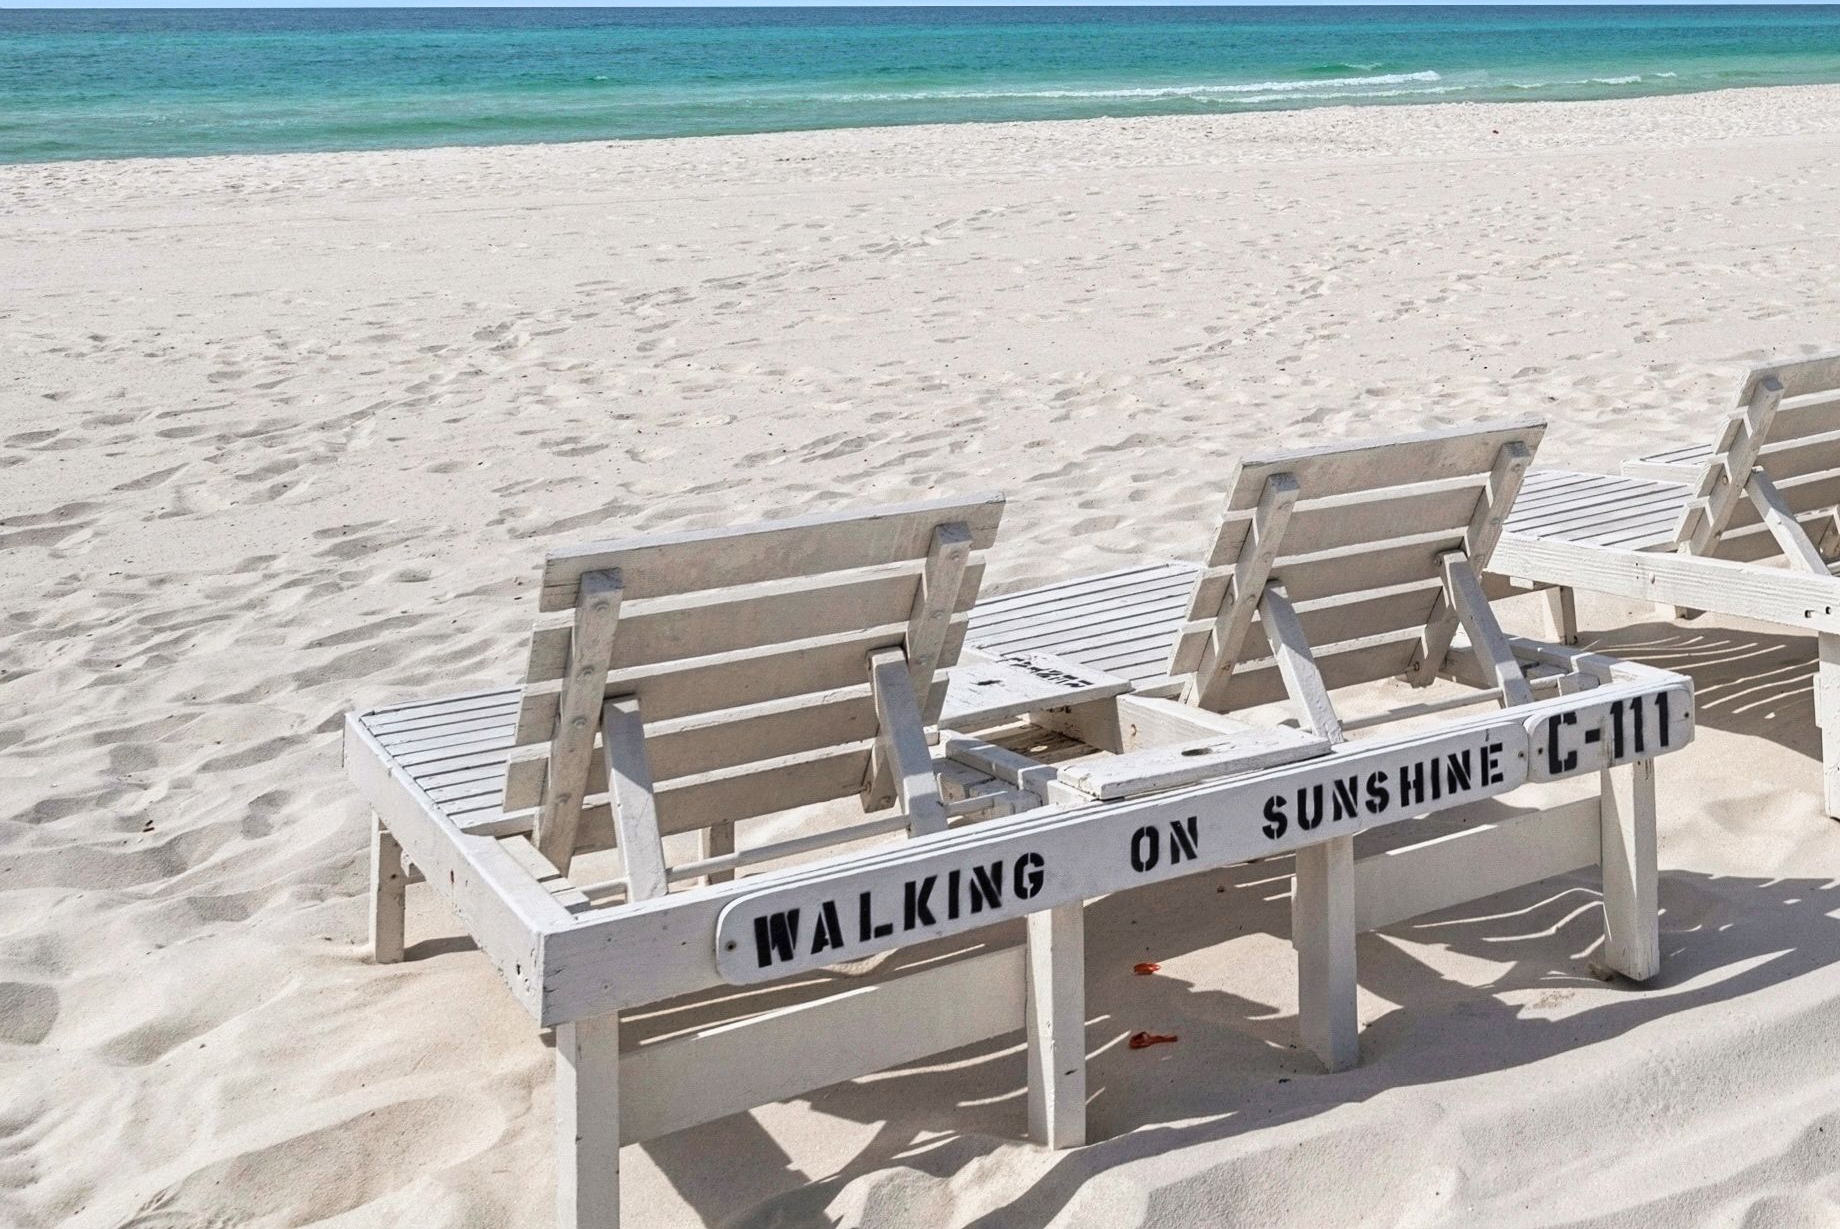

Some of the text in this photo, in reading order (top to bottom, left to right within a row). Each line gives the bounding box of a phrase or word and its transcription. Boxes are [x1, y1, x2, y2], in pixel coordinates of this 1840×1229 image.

[1547, 691, 1670, 774] C-111
[753, 741, 1505, 969] WALKING ON SUNSHINE
